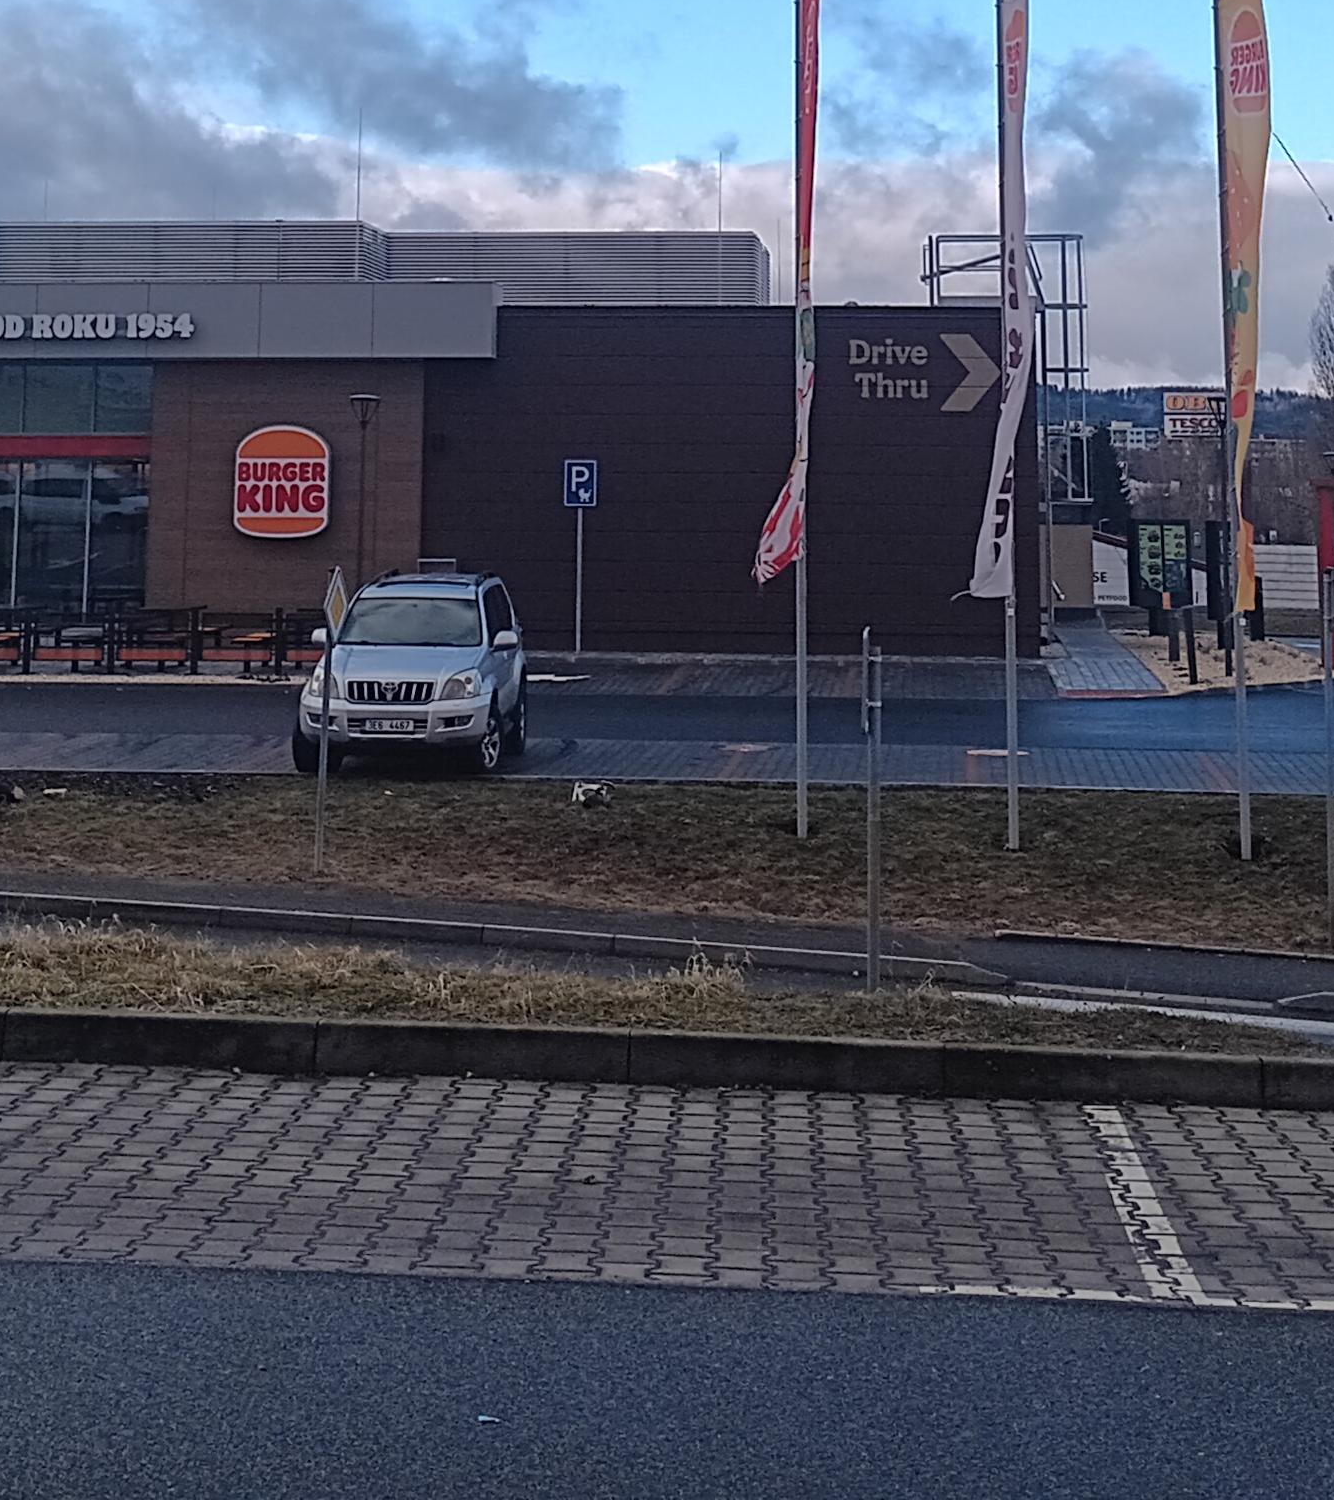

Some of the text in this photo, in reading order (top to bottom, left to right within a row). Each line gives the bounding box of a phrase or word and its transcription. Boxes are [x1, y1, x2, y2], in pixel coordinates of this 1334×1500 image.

[31, 313, 116, 339] ROKU
[125, 313, 195, 339] 1954
[848, 338, 929, 365] Drive
[854, 372, 929, 399] Thru
[238, 462, 326, 482] BURGER
[571, 466, 590, 491] P
[237, 484, 326, 513] KING
